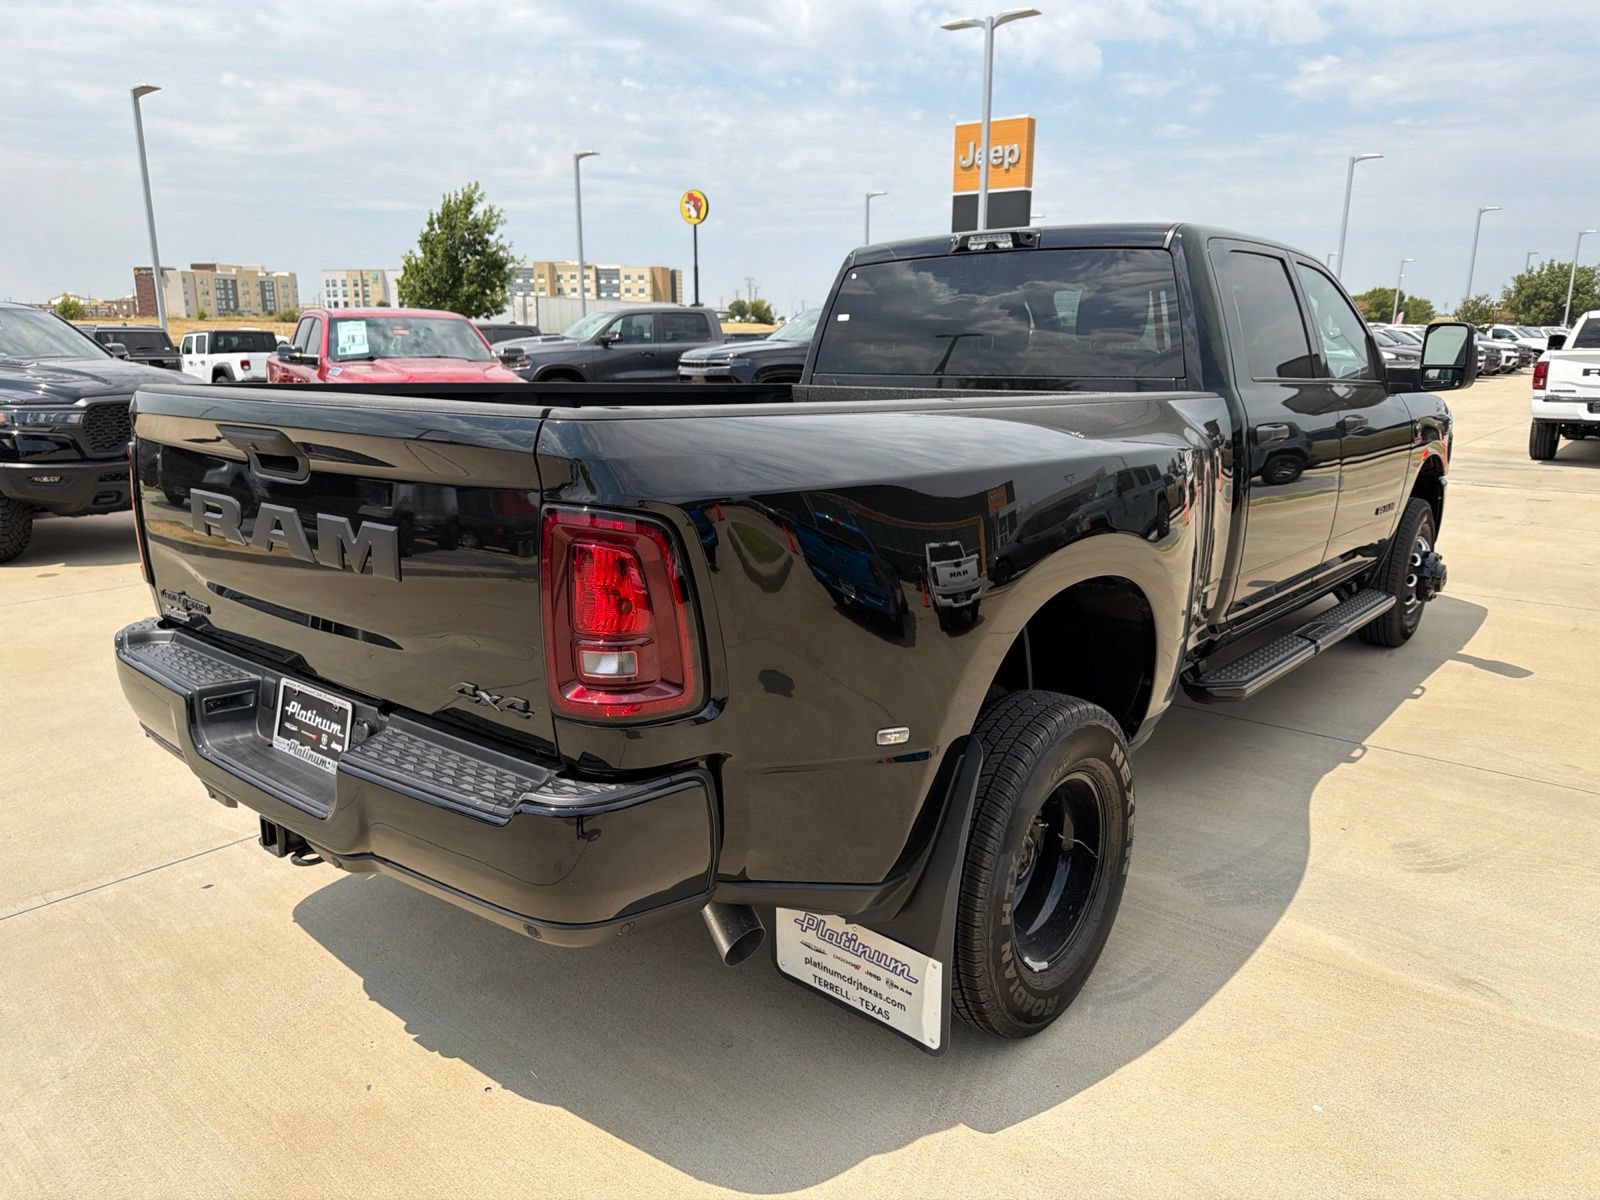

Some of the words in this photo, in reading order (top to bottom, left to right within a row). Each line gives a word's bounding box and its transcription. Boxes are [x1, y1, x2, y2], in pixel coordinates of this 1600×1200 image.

[190, 488, 402, 582] RAM
[284, 700, 344, 738] Platinum
[287, 740, 330, 770] Platinum
[1110, 742, 1135, 875] NEXEN
[794, 912, 919, 984] Platinum
[804, 955, 907, 1012] platinumcdrjtexas.com
[812, 973, 851, 1001] TERRELL
[858, 996, 891, 1021] TEXAS
